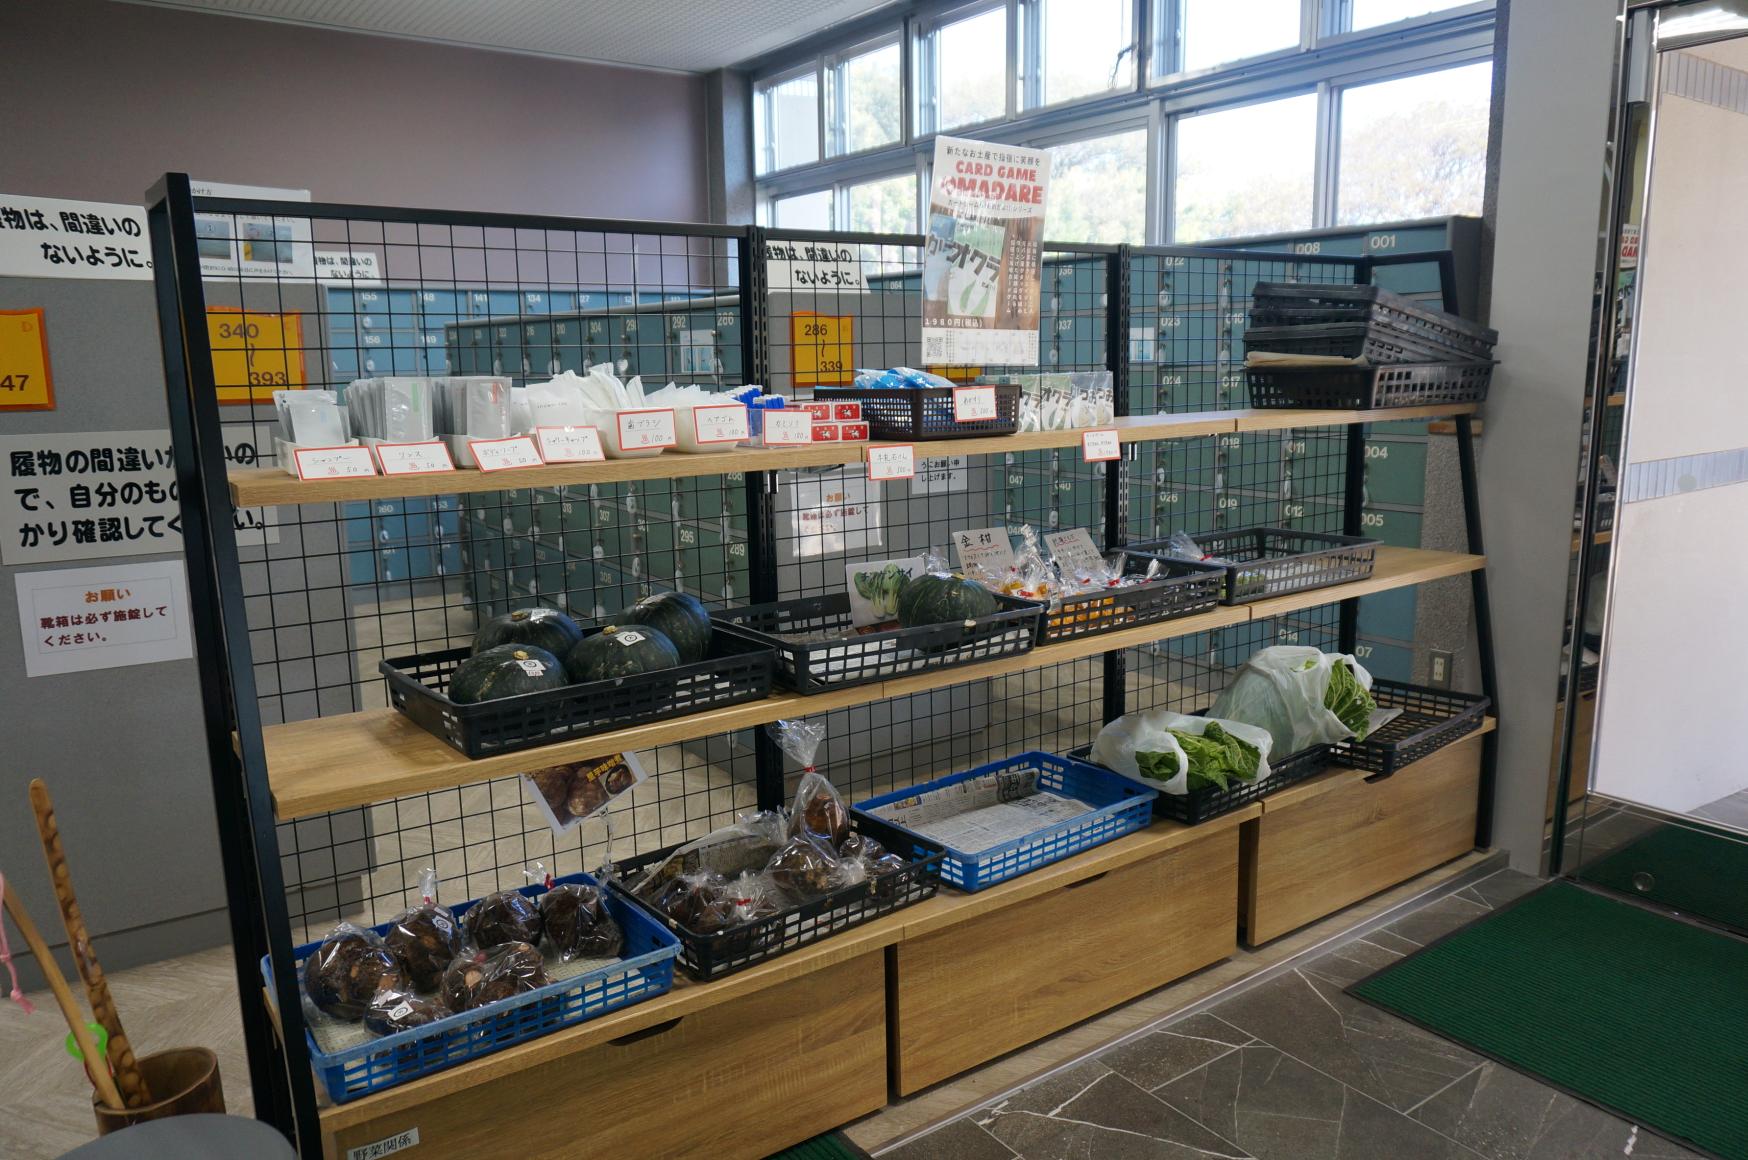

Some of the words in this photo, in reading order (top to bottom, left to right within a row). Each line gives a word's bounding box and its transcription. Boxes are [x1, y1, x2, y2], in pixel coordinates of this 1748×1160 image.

[956, 160, 993, 177] CARD
[997, 165, 1037, 182] GAME
[1296, 242, 1321, 255] 008
[1371, 235, 1396, 249] 001
[40, 242, 153, 269] ないように。
[794, 269, 860, 286] ないように。
[361, 293, 378, 301] 155
[473, 293, 489, 302] 141
[672, 315, 687, 329] 292
[717, 311, 735, 327] 286
[1160, 316, 1181, 327] 023
[218, 323, 260, 339] 340
[804, 323, 828, 336] 286
[819, 360, 843, 373] 339
[249, 371, 287, 386] 393
[1220, 436, 1241, 449] 018
[1009, 474, 1024, 487] 047
[1159, 491, 1179, 504] 026
[1218, 497, 1238, 510] 019
[680, 529, 695, 545] 295
[729, 542, 746, 557] 289
[84, 588, 132, 604] お願い
[40, 605, 168, 630] 靴箱は必ず施錠して
[43, 632, 108, 648] ください。
